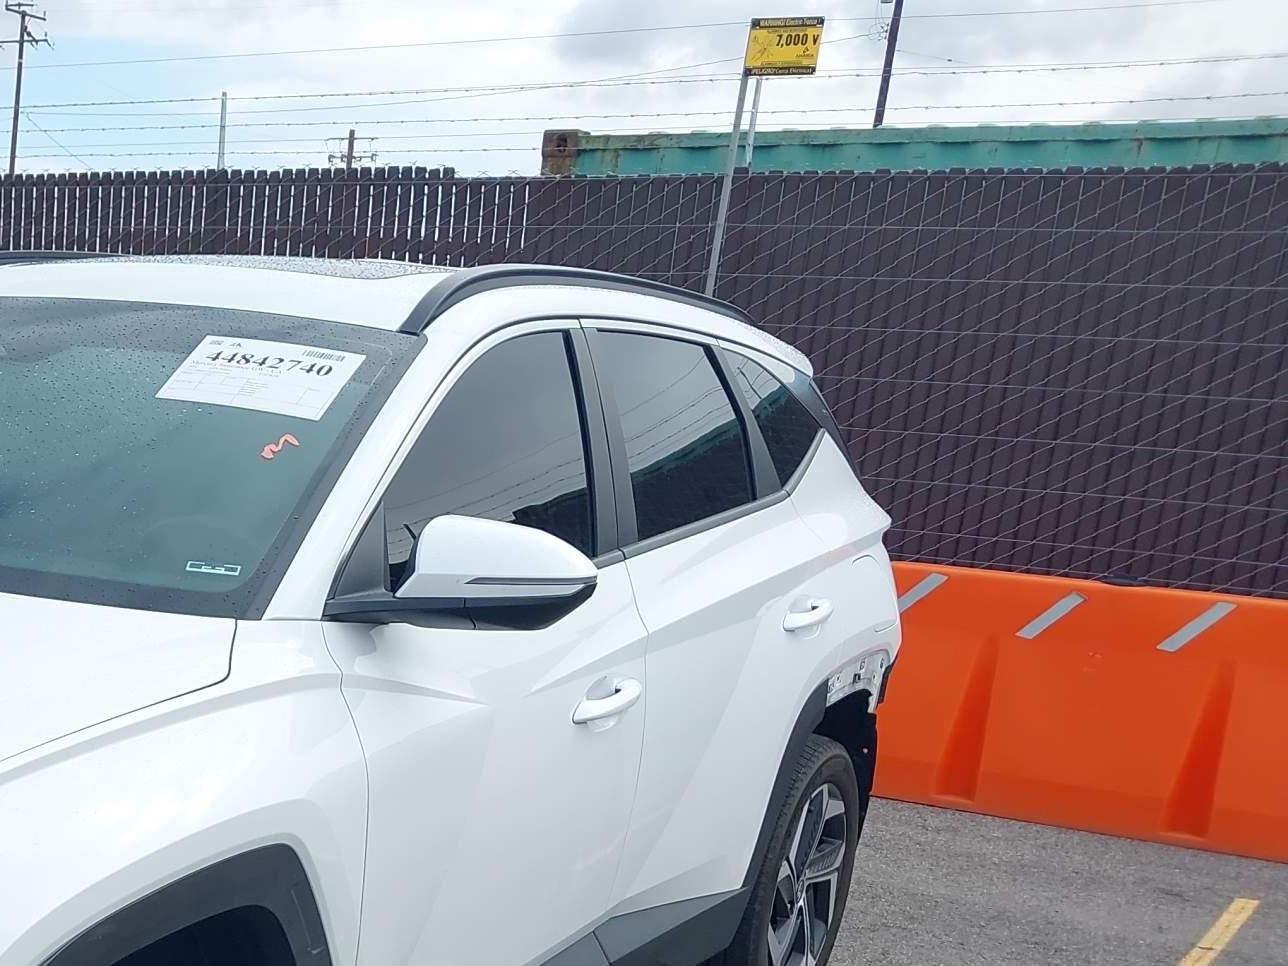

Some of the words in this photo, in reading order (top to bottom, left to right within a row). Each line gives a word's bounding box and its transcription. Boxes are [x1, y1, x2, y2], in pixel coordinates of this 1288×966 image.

[776, 34, 808, 48] 7,000
[812, 34, 820, 46] V
[206, 350, 333, 377] 44842740
